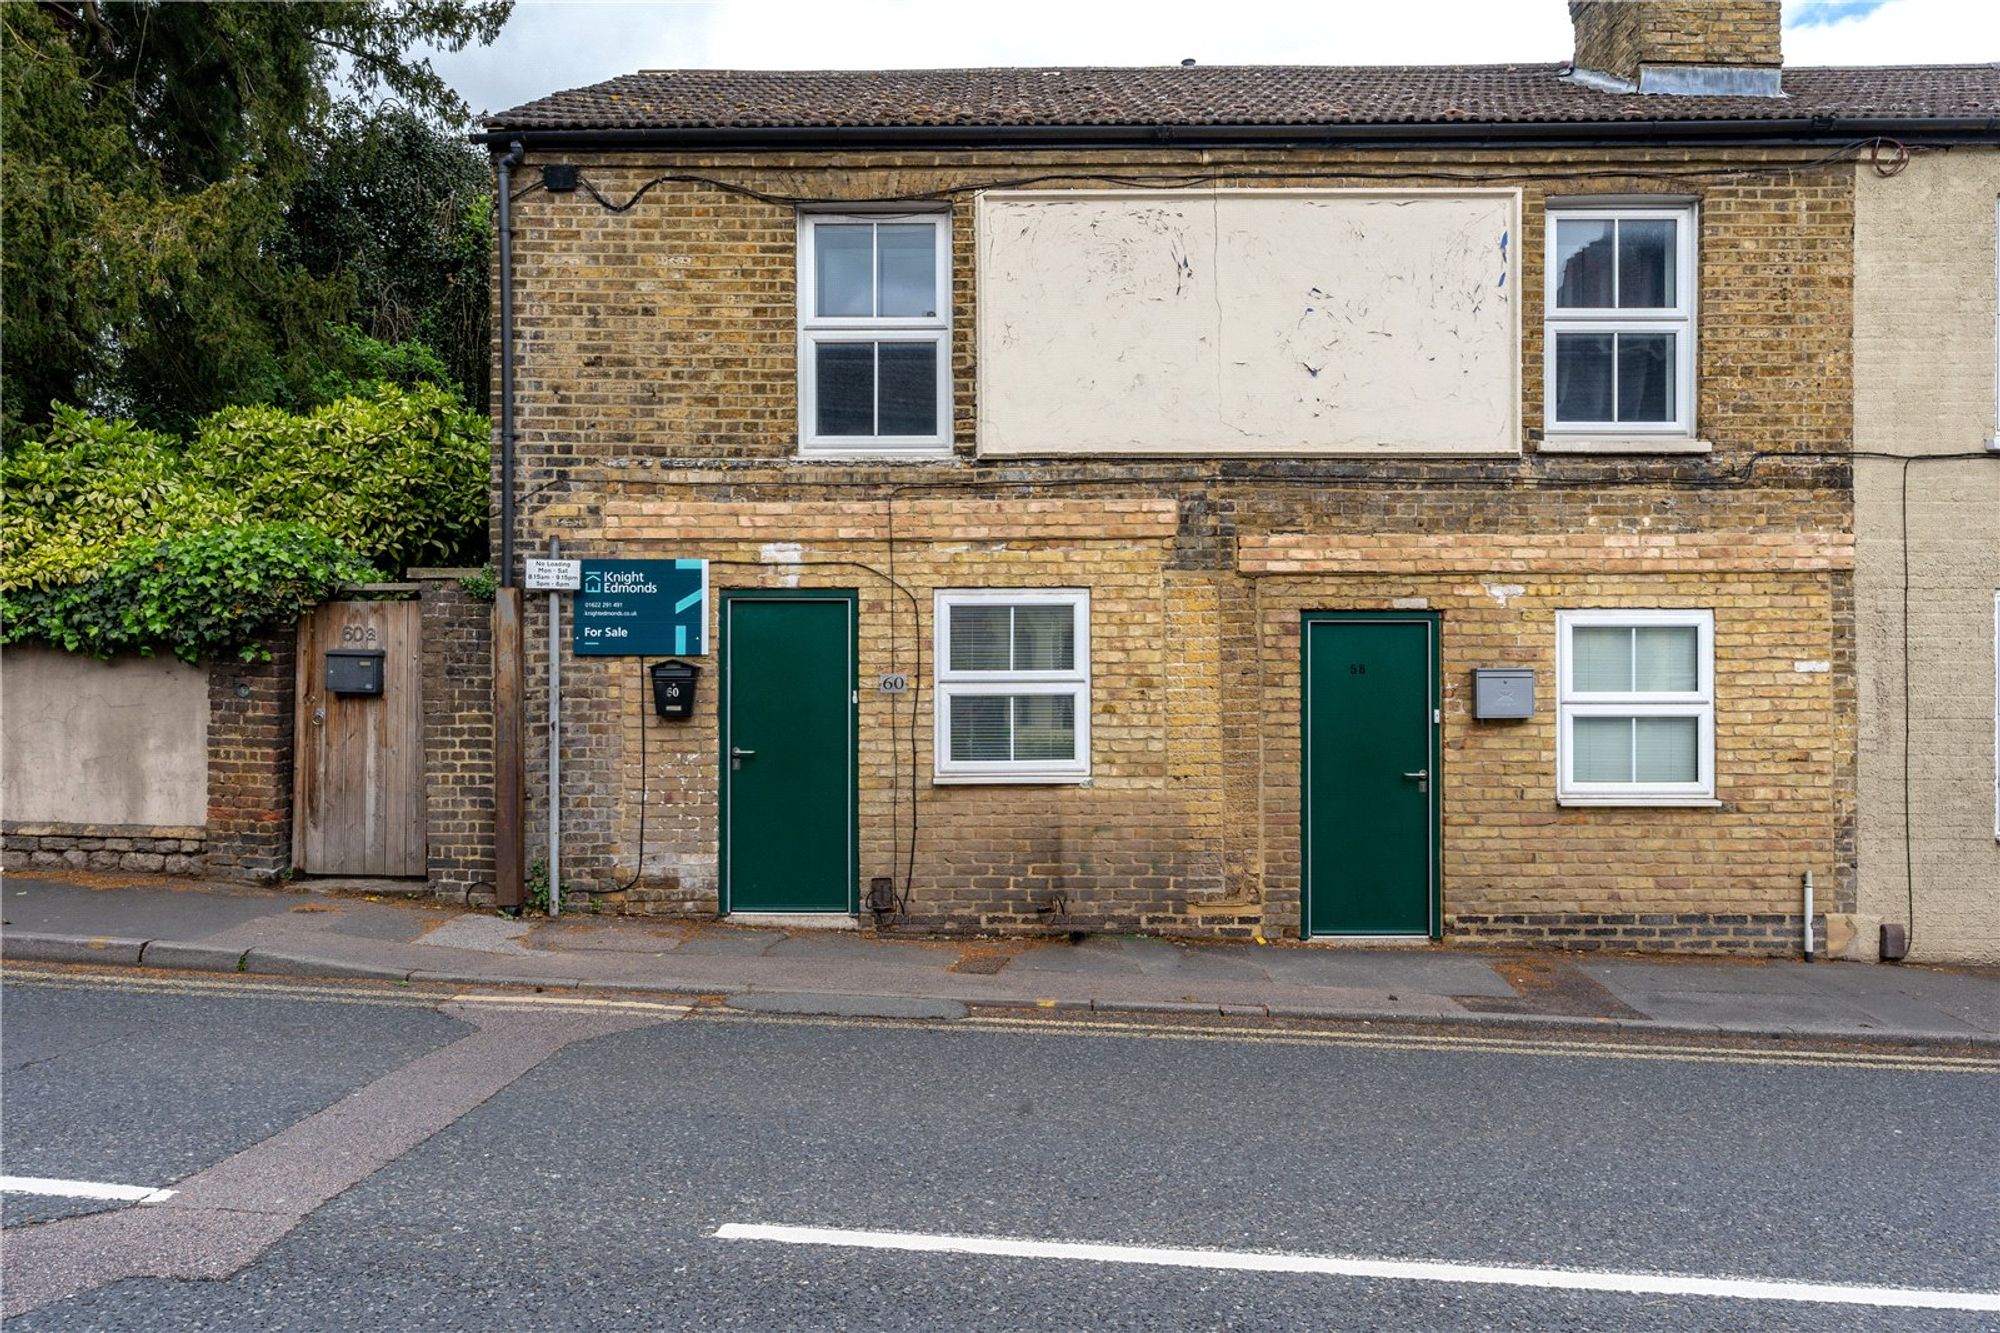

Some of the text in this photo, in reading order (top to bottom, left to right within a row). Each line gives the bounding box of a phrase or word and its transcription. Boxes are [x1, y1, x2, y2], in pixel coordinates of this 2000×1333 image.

[604, 571, 644, 584] Knight
[604, 582, 657, 593] Edmonds
[584, 627, 628, 637] For Sale
[1350, 663, 1365, 675] 58
[882, 676, 904, 690] 60
